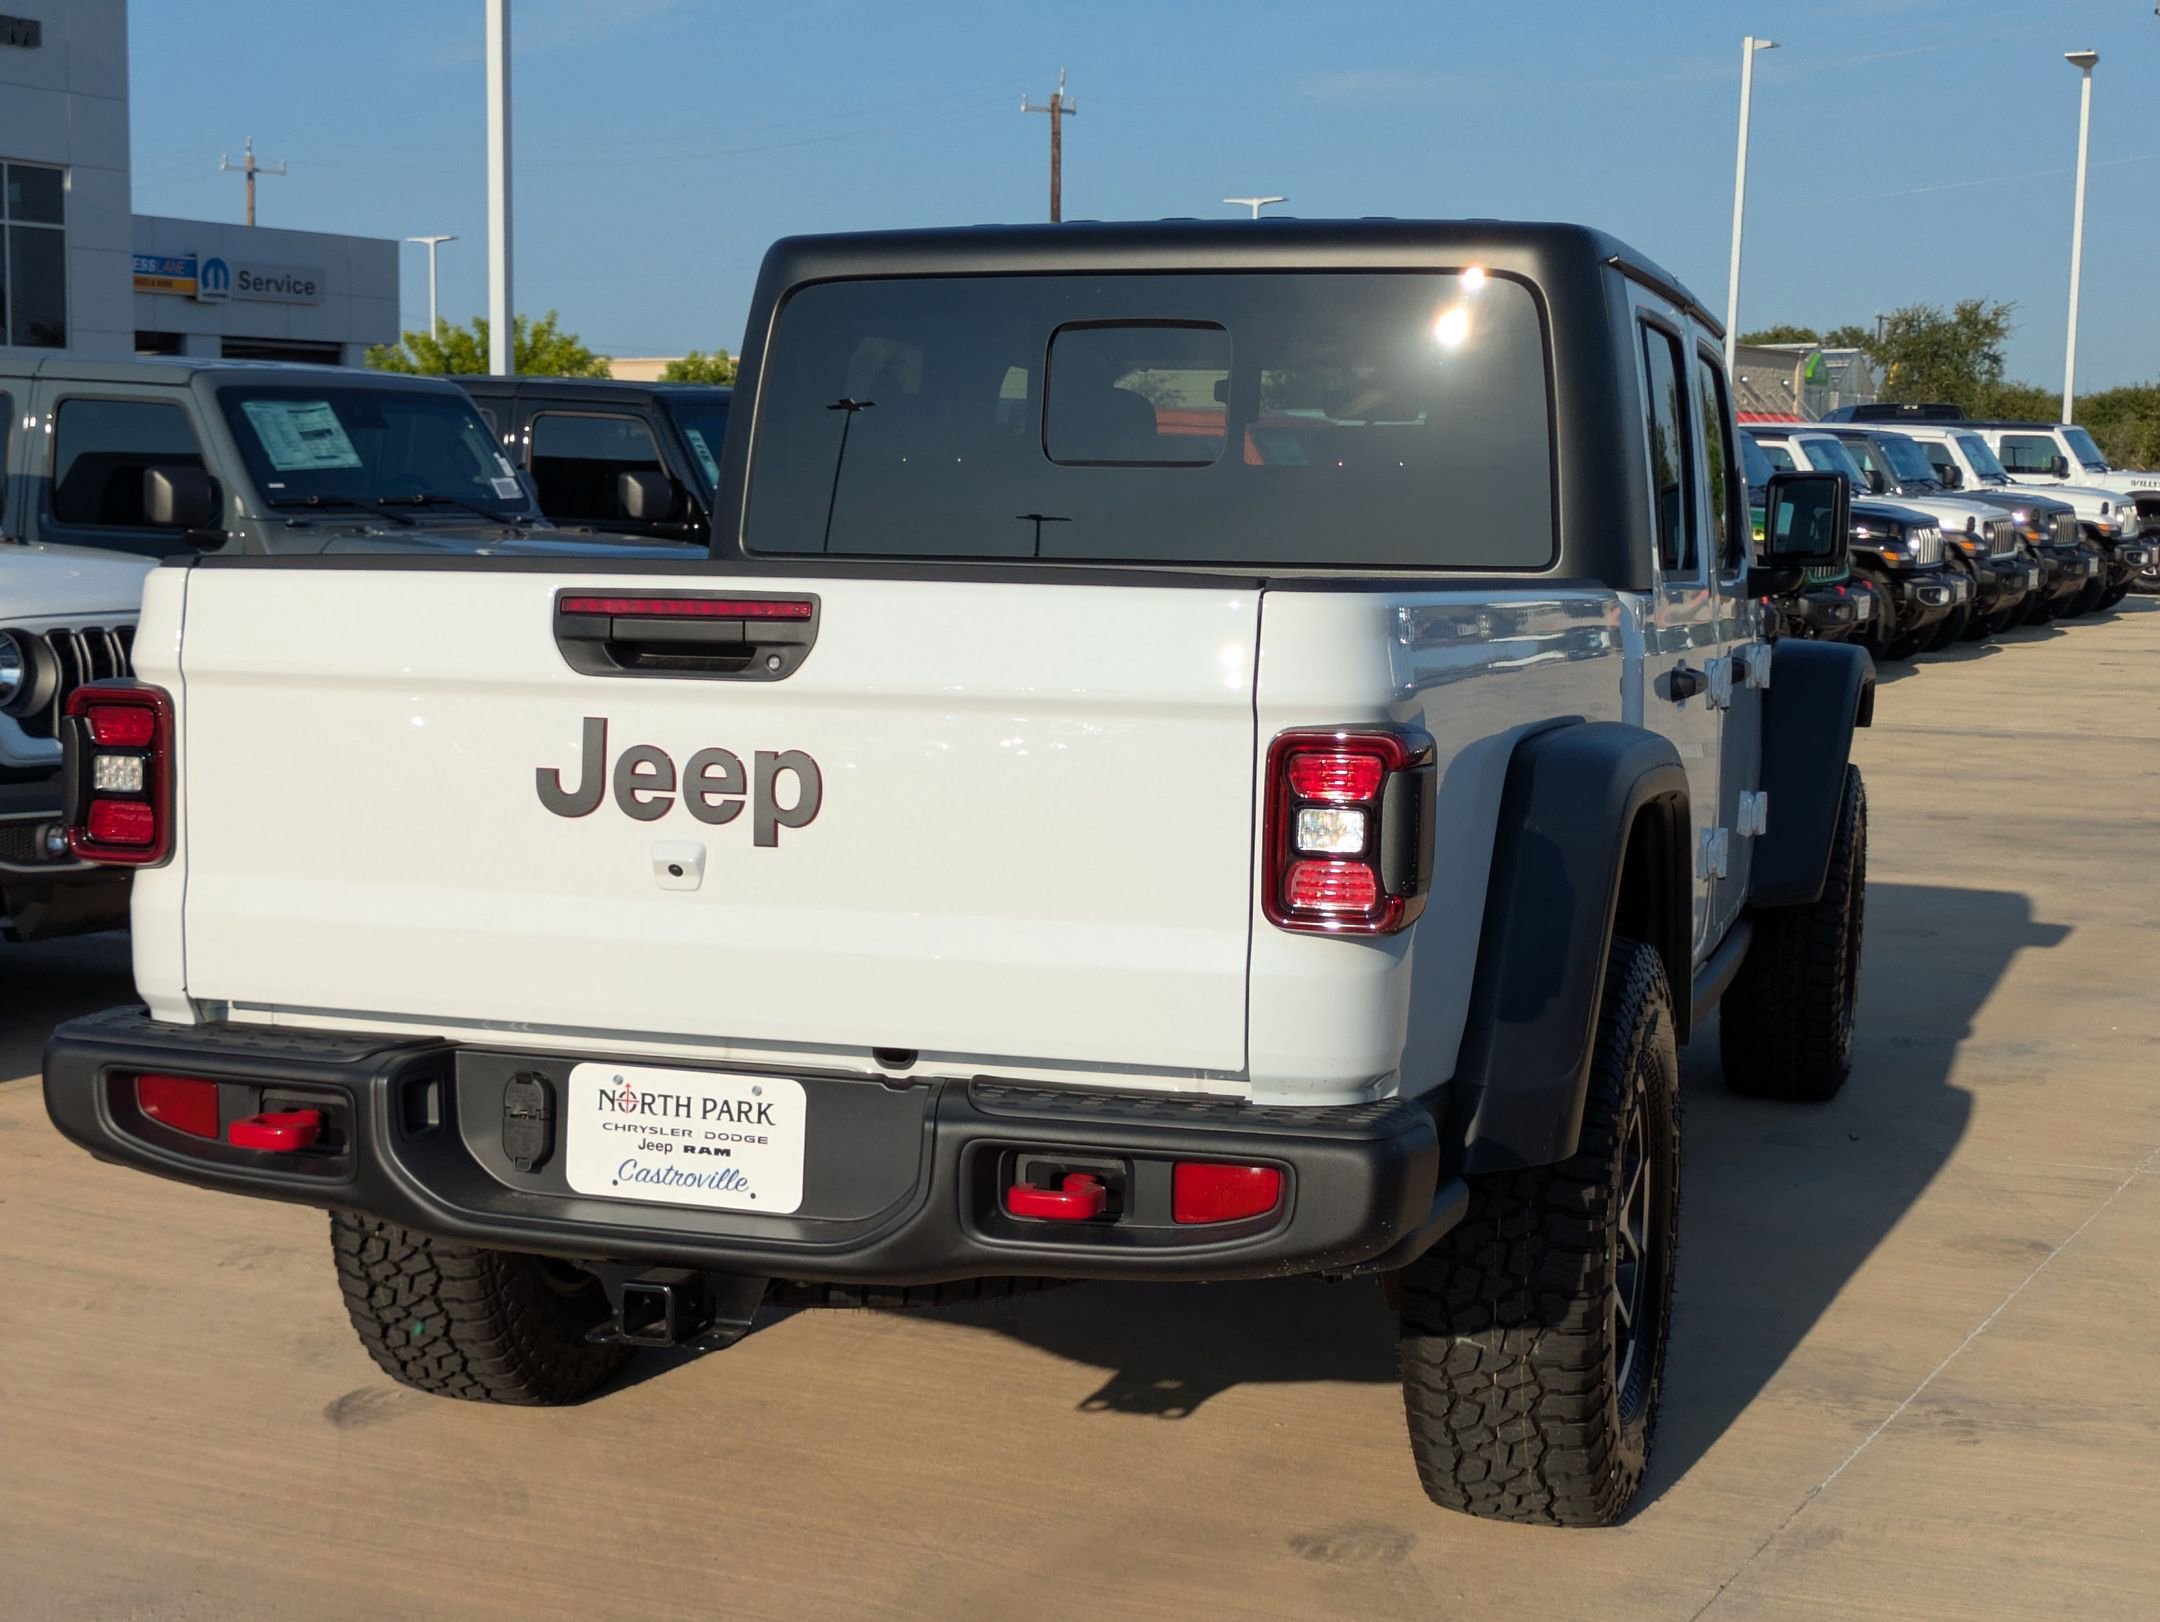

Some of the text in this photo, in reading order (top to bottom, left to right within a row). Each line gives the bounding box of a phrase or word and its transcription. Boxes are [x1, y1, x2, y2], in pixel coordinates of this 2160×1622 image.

[238, 270, 315, 295] Service
[536, 716, 823, 847] Jeep
[598, 1087, 776, 1126] NORTH PARK
[602, 1122, 769, 1145] CHRYSLER DODGE
[638, 1138, 731, 1157] Jeep RAM
[618, 1158, 749, 1193] Castroville
